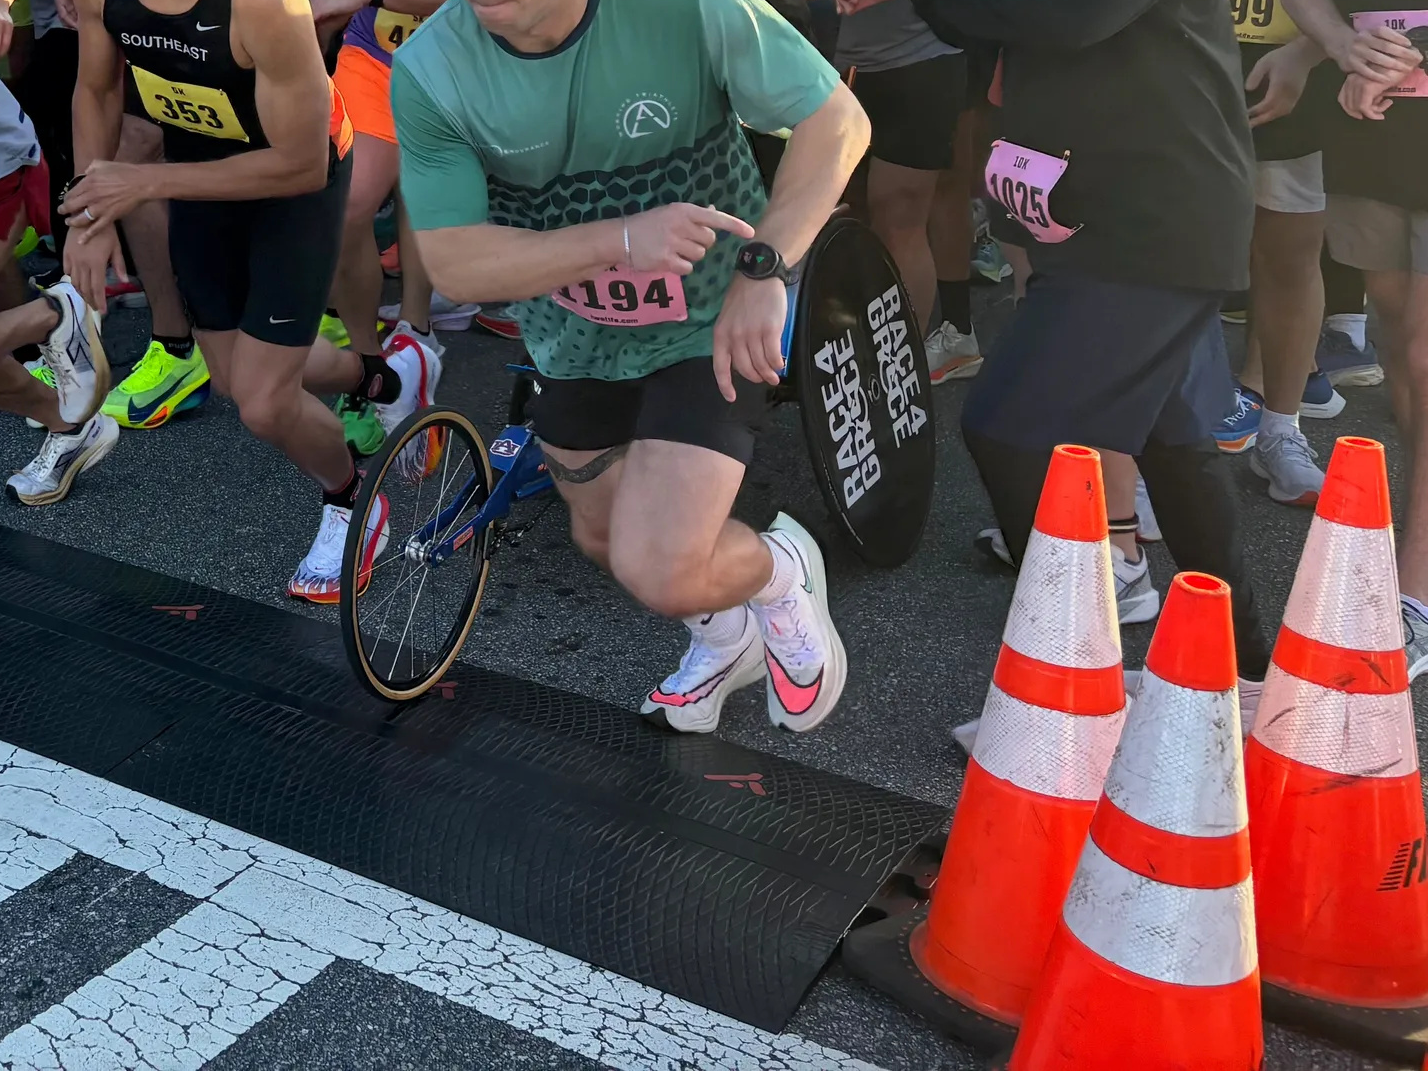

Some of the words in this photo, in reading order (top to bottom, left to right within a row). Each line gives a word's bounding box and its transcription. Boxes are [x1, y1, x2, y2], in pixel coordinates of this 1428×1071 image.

[1384, 18, 1406, 30] 10K
[121, 32, 208, 61] SOUTHEAST
[155, 94, 224, 129] 353
[1013, 155, 1030, 170] 10K
[990, 173, 1050, 228] 1025
[814, 340, 837, 375] 4
[881, 284, 921, 406] RACE
[910, 404, 928, 436] 4
[821, 373, 865, 509] RACE
